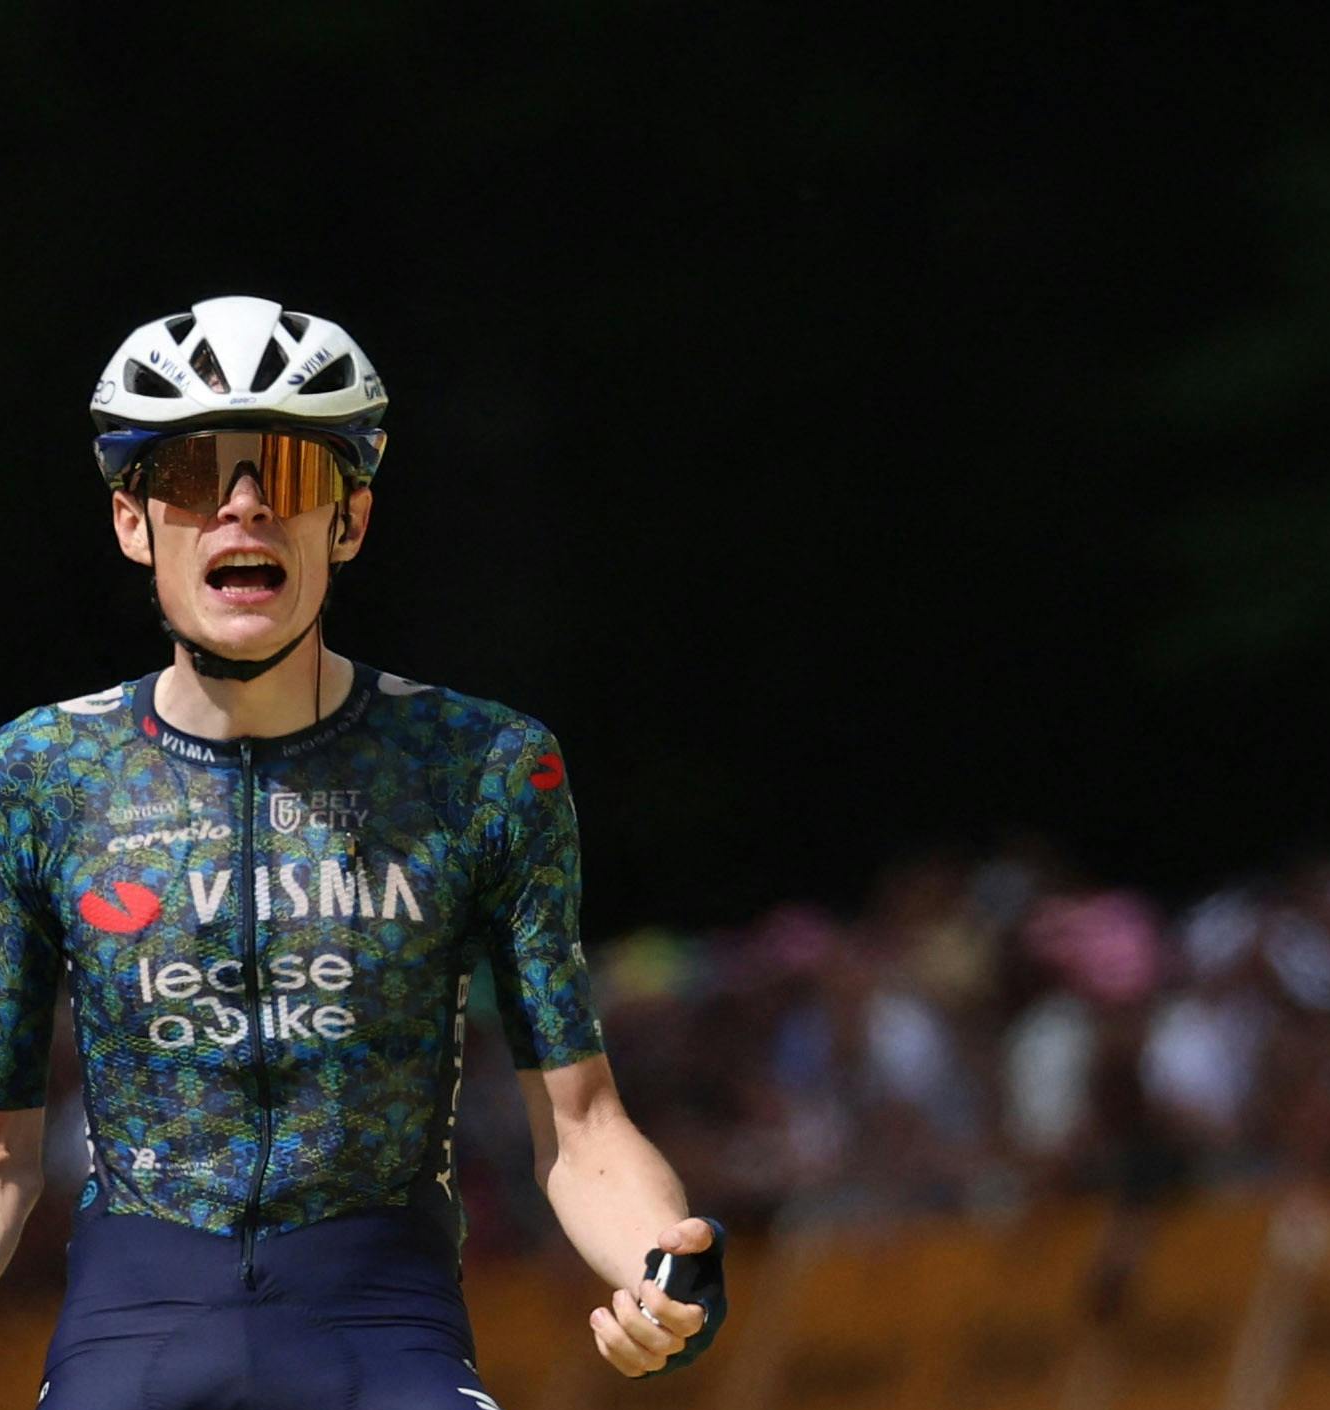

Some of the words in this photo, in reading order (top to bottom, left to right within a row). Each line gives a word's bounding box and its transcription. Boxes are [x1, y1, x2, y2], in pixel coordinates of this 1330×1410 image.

[302, 347, 333, 373] VISMA
[161, 731, 216, 763] VISMA
[188, 860, 423, 924] VISMA
